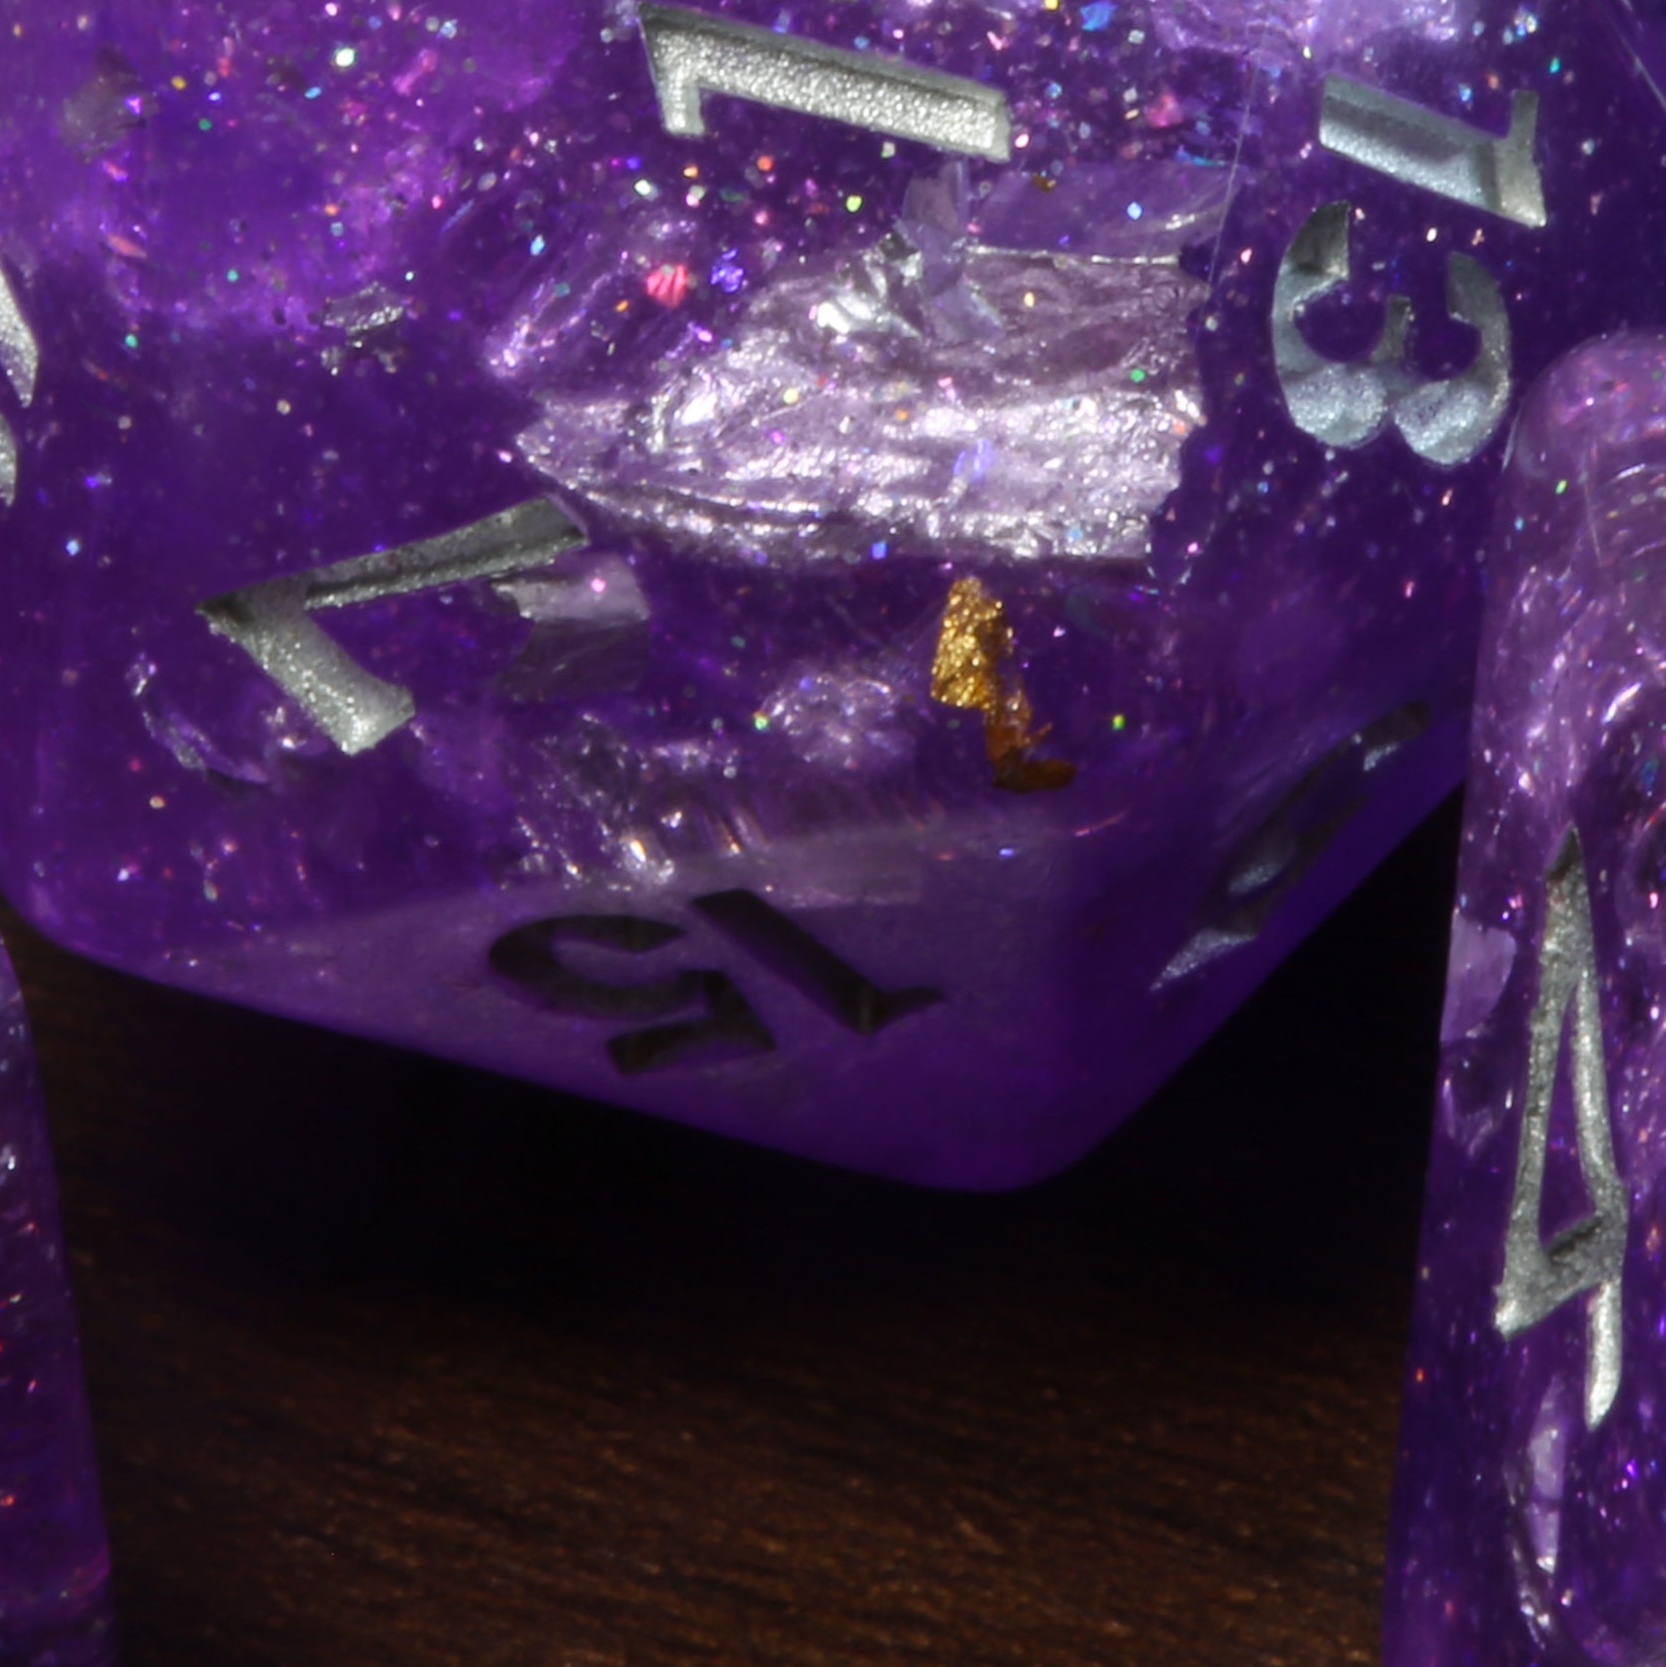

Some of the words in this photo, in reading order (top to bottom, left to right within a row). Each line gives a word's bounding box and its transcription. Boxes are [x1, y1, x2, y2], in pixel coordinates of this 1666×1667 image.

[1269, 72, 1547, 466] 13
[195, 494, 593, 759] 7
[488, 887, 947, 1078] 15
[1495, 828, 1629, 1430] 4
